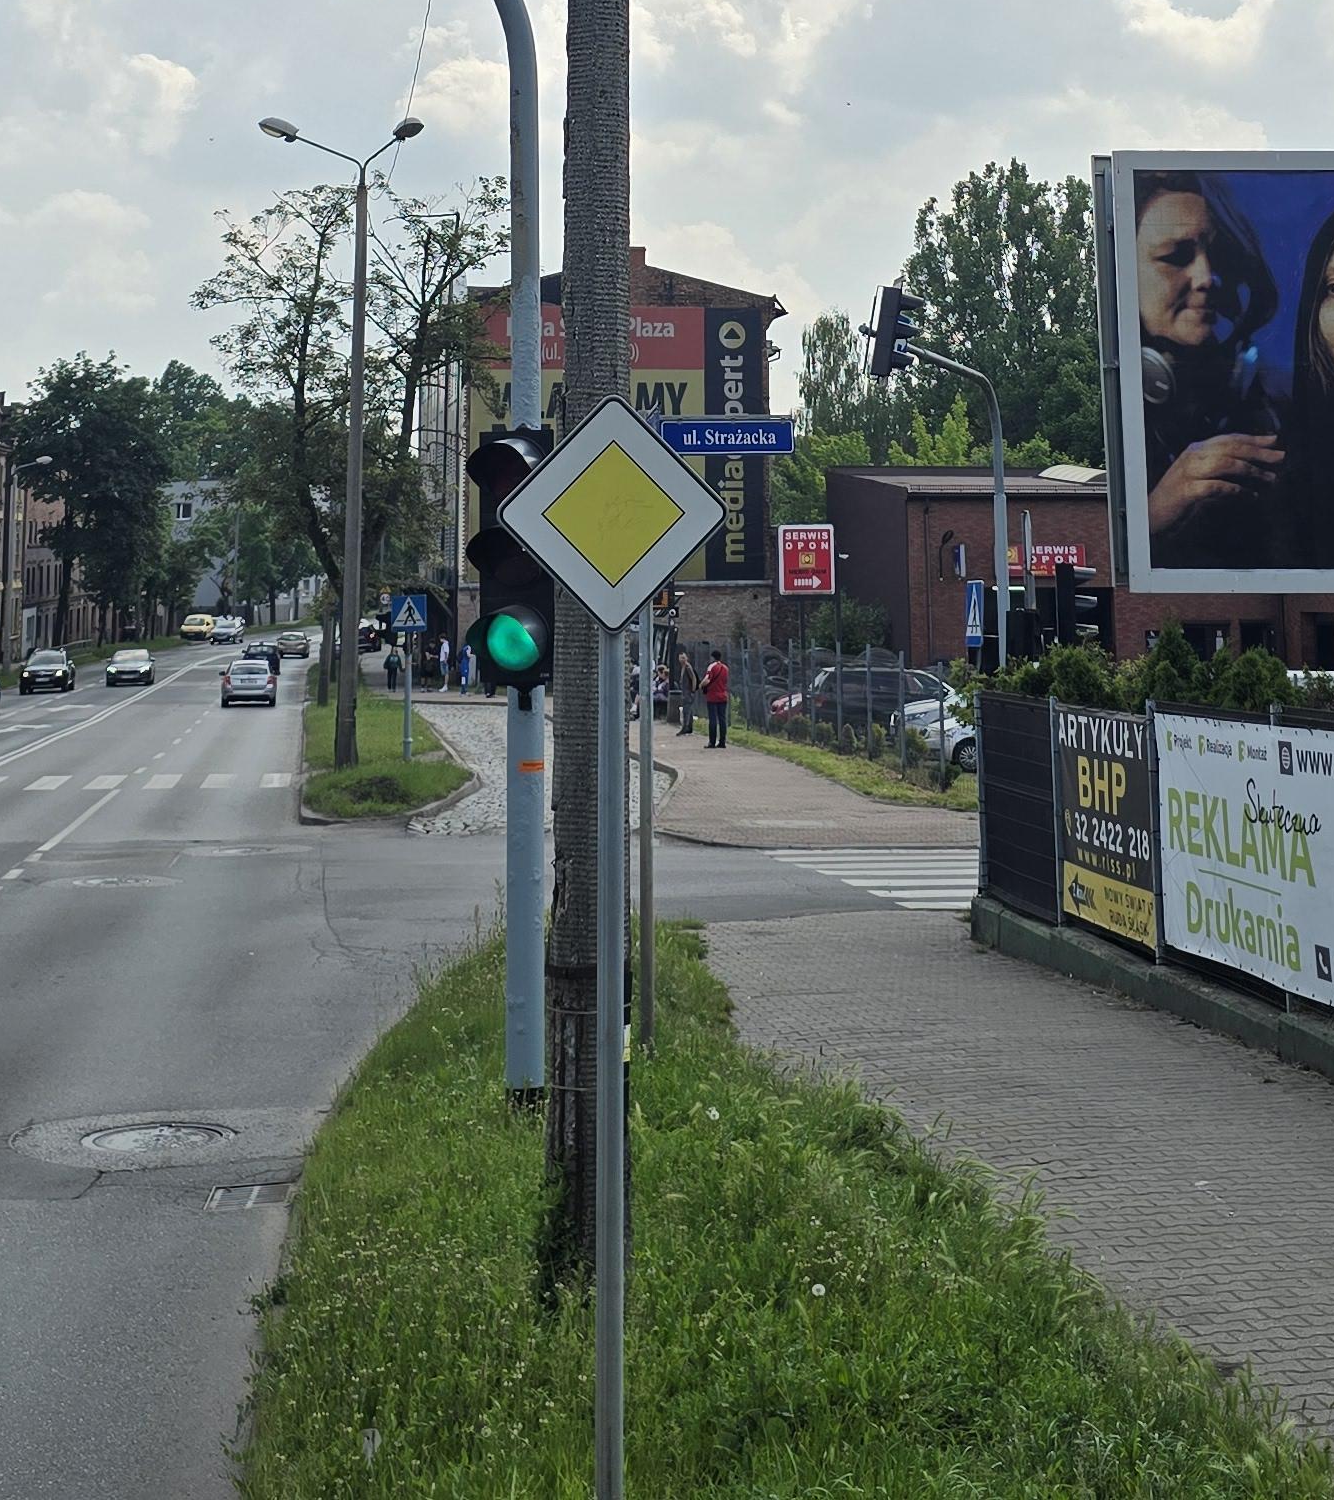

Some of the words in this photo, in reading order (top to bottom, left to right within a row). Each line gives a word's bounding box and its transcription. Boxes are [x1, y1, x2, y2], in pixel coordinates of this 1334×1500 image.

[683, 429, 701, 445] ul.
[705, 428, 777, 445] Strażacka
[785, 531, 828, 540] SERWIS
[785, 541, 829, 550] OPON
[1058, 712, 1144, 760] ARTYKUŁY
[1173, 734, 1193, 751] Projekt
[1206, 738, 1233, 759] Realizacja
[1246, 745, 1267, 761] Montaż
[1077, 755, 1126, 816] BHP
[1244, 778, 1322, 835] Skuteczna
[1074, 811, 1089, 843] 32
[1092, 816, 1124, 854] 2422
[1128, 826, 1150, 861] 218
[1167, 787, 1317, 888] REKLAMA
[1127, 911, 1150, 938] ŚLĄSK
[1186, 880, 1302, 972] Drukarnia
